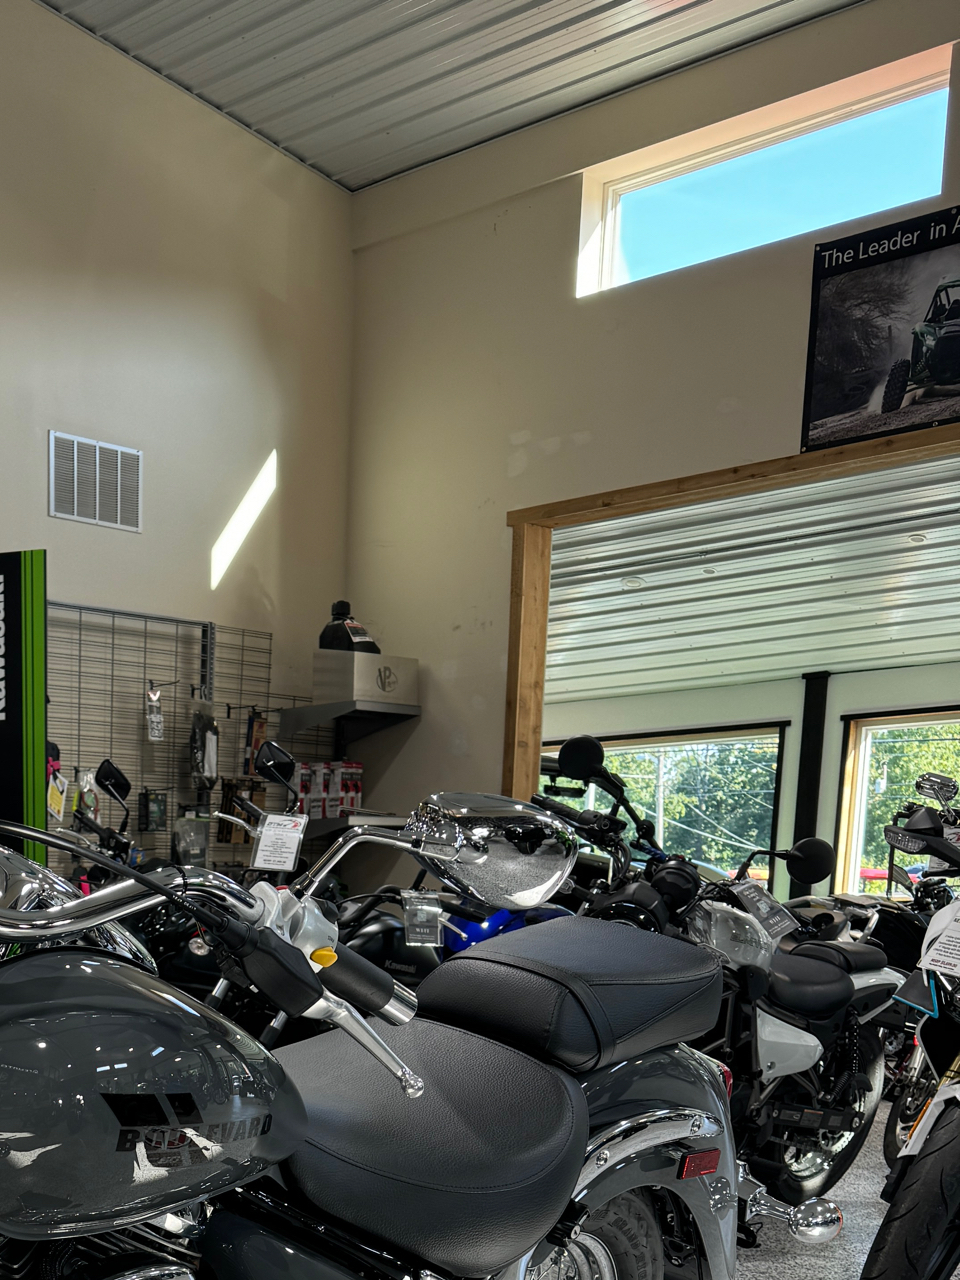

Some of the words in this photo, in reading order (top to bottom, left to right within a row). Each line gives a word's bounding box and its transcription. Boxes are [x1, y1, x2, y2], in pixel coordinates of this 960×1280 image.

[821, 249, 854, 268] The
[859, 230, 921, 259] Leader
[930, 222, 947, 240] in
